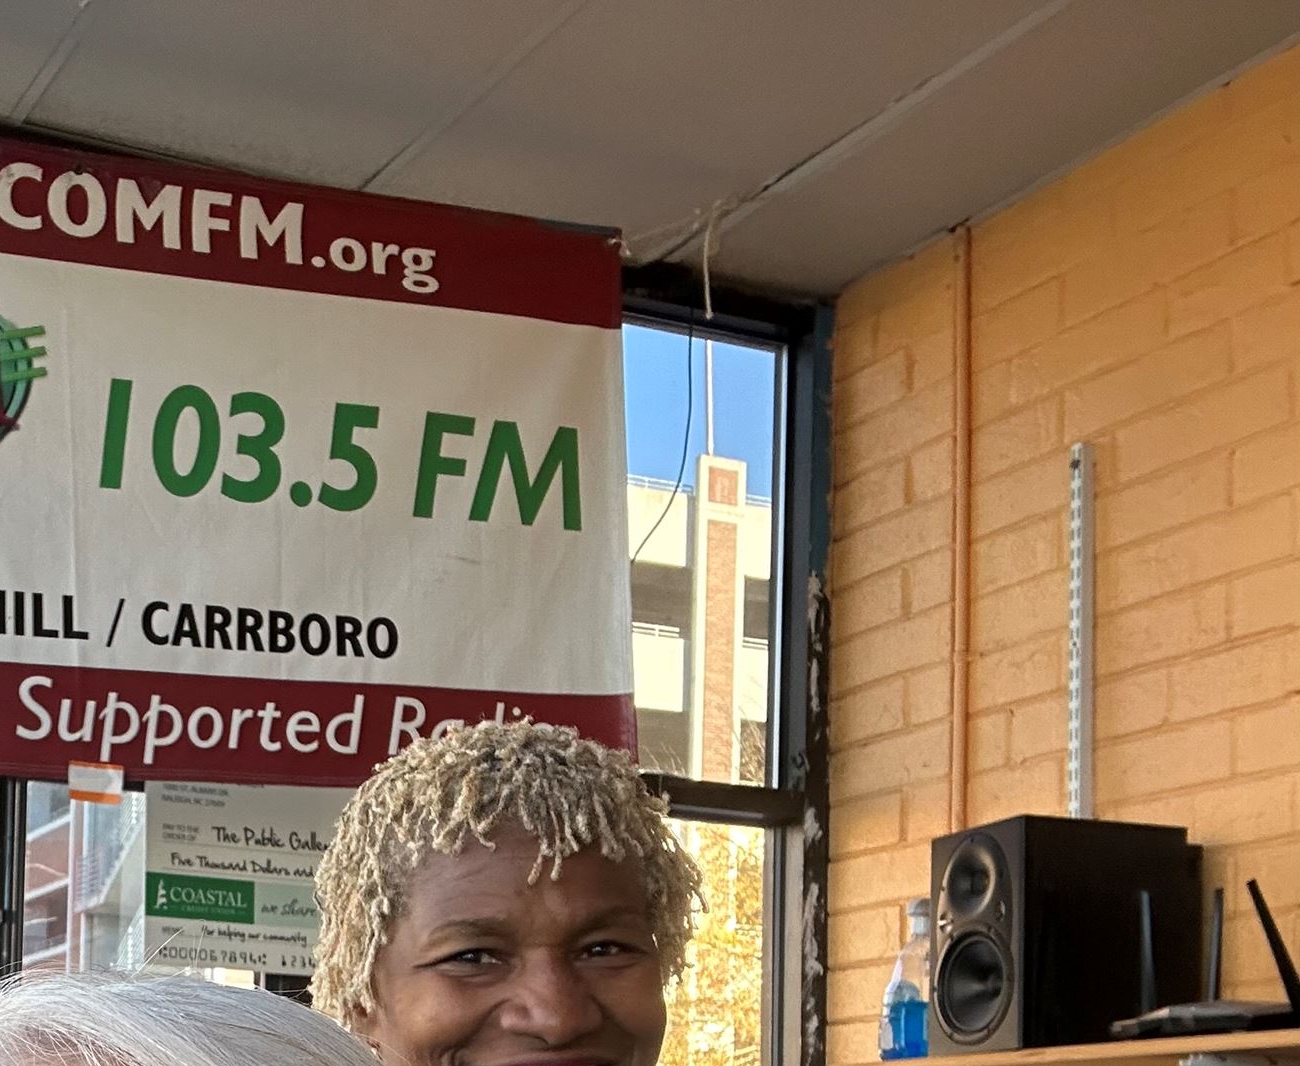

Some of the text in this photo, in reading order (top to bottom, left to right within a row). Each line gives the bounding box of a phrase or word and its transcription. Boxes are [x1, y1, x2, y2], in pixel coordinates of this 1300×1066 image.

[100, 377, 582, 531] 103.5 FM
[141, 601, 399, 659] CARRBORO
[16, 676, 363, 764] Supported
[171, 852, 194, 867] Five
[211, 826, 330, 852] The Public Galler
[170, 886, 248, 908] COASTAL
